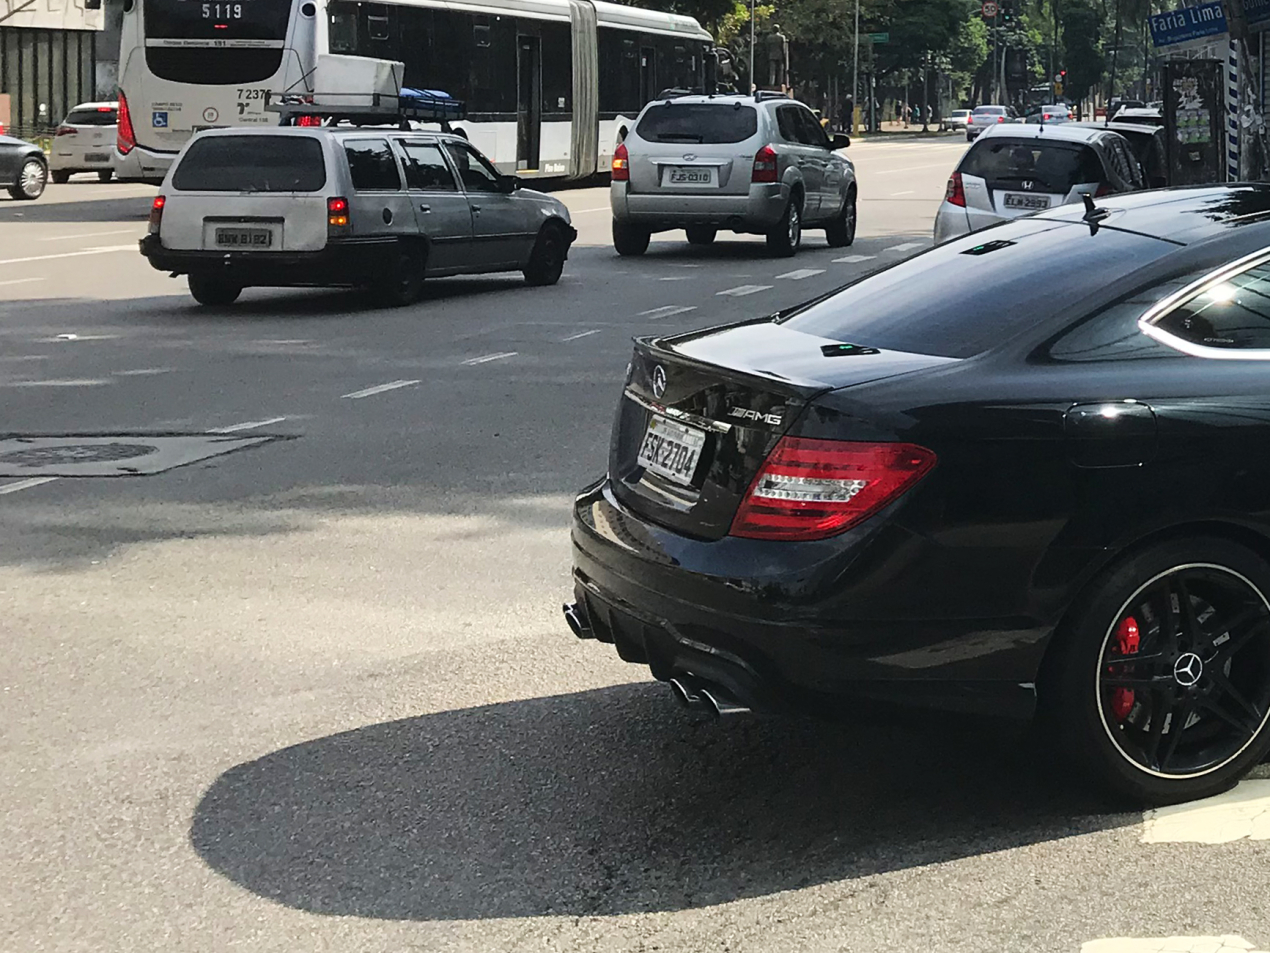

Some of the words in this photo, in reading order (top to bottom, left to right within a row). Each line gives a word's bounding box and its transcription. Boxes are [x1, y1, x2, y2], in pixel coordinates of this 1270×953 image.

[202, 4, 242, 19] 5119
[1151, 14, 1186, 33] Faria
[1190, 5, 1224, 24] Lima
[743, 410, 782, 425] AMG
